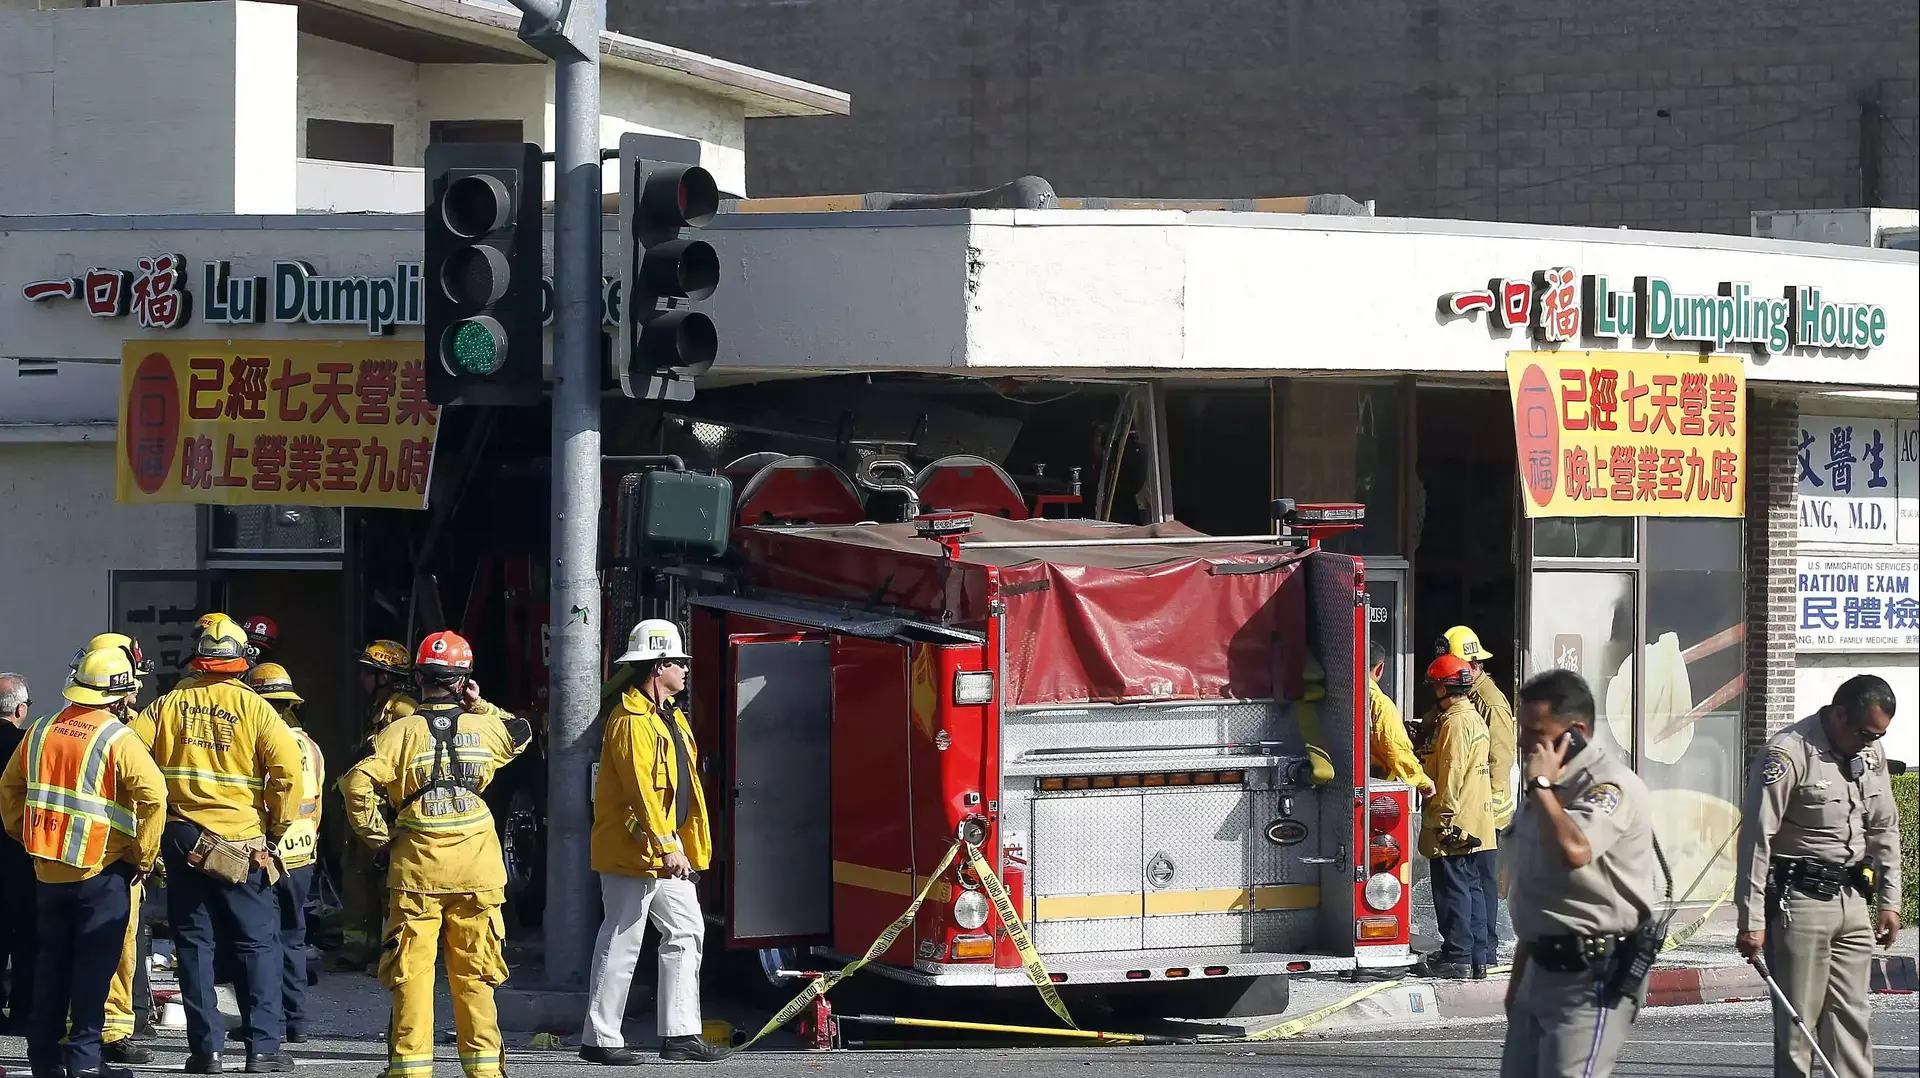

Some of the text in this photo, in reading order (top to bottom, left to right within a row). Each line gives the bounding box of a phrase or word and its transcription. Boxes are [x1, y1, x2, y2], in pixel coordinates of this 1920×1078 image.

[22, 253, 425, 335] 一口福 Lu Dumpli
[1450, 266, 1887, 353] 一口福 Lu Dumpling House
[1559, 367, 1737, 437] 已經七天營業
[1524, 387, 1553, 491] 一口福
[181, 432, 433, 495] 晚上營業至九時
[1563, 444, 1737, 502] 晚上營業至九時
[1849, 502, 1887, 530] M.D.
[1808, 561, 1823, 571] U.S.
[1825, 562, 1873, 571] IMMIGRATION
[1876, 562, 1911, 571] SERVICES
[1798, 573, 1909, 593] RATION EXAM
[1800, 597, 1919, 629] 民體檢
[1840, 636, 1863, 644] FAMILY
[1866, 636, 1898, 644] MEDICINE
[179, 700, 239, 724] Pasadena
[53, 726, 88, 740] FIRE DEPT.
[68, 719, 98, 731] COUNTY
[180, 716, 233, 744] FIRE
[180, 736, 231, 752] DEPARTMENT
[284, 834, 312, 850] U-10
[982, 872, 1030, 951] FIRE LINE DO NOT CROSS
[881, 927, 896, 943] NOT
[866, 940, 888, 962] CROSS
[1028, 960, 1047, 984] CROSS
[793, 991, 809, 1008] NOT
[805, 985, 817, 998] DO
[775, 1003, 798, 1025] CROSS
